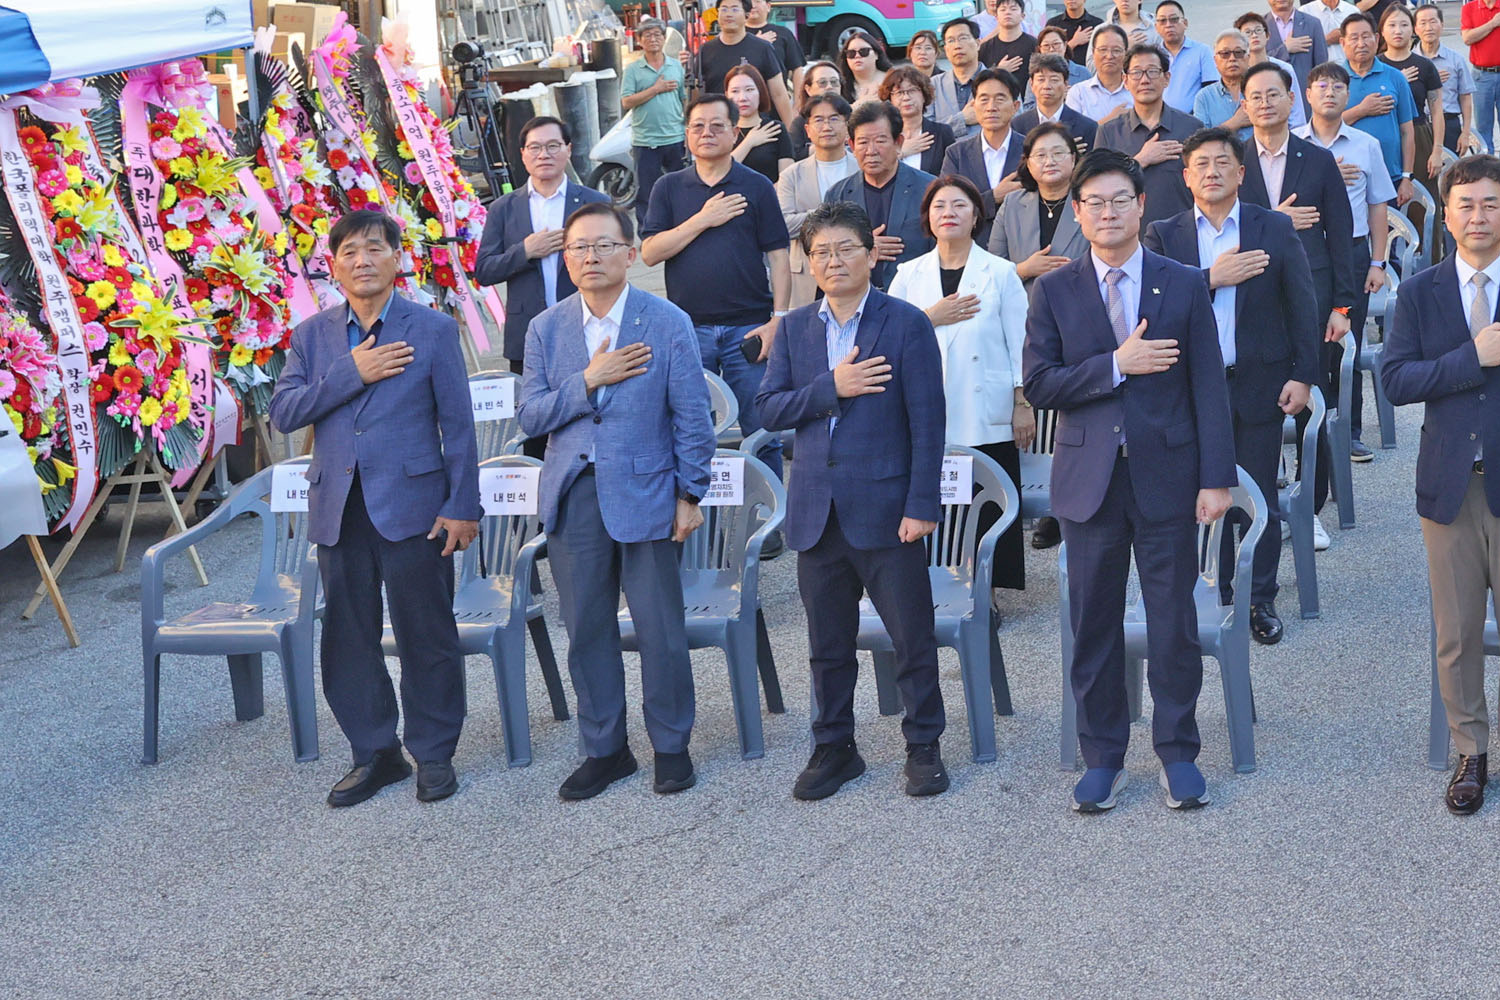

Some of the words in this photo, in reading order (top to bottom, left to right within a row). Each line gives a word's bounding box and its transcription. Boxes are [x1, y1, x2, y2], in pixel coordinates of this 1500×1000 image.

[3, 151, 52, 265] 한국폴리텍대학
[45, 273, 84, 357] 원주캠퍼스
[65, 367, 83, 394] 학장
[71, 403, 94, 455] 권민수
[493, 492, 527, 503] 내빈석
